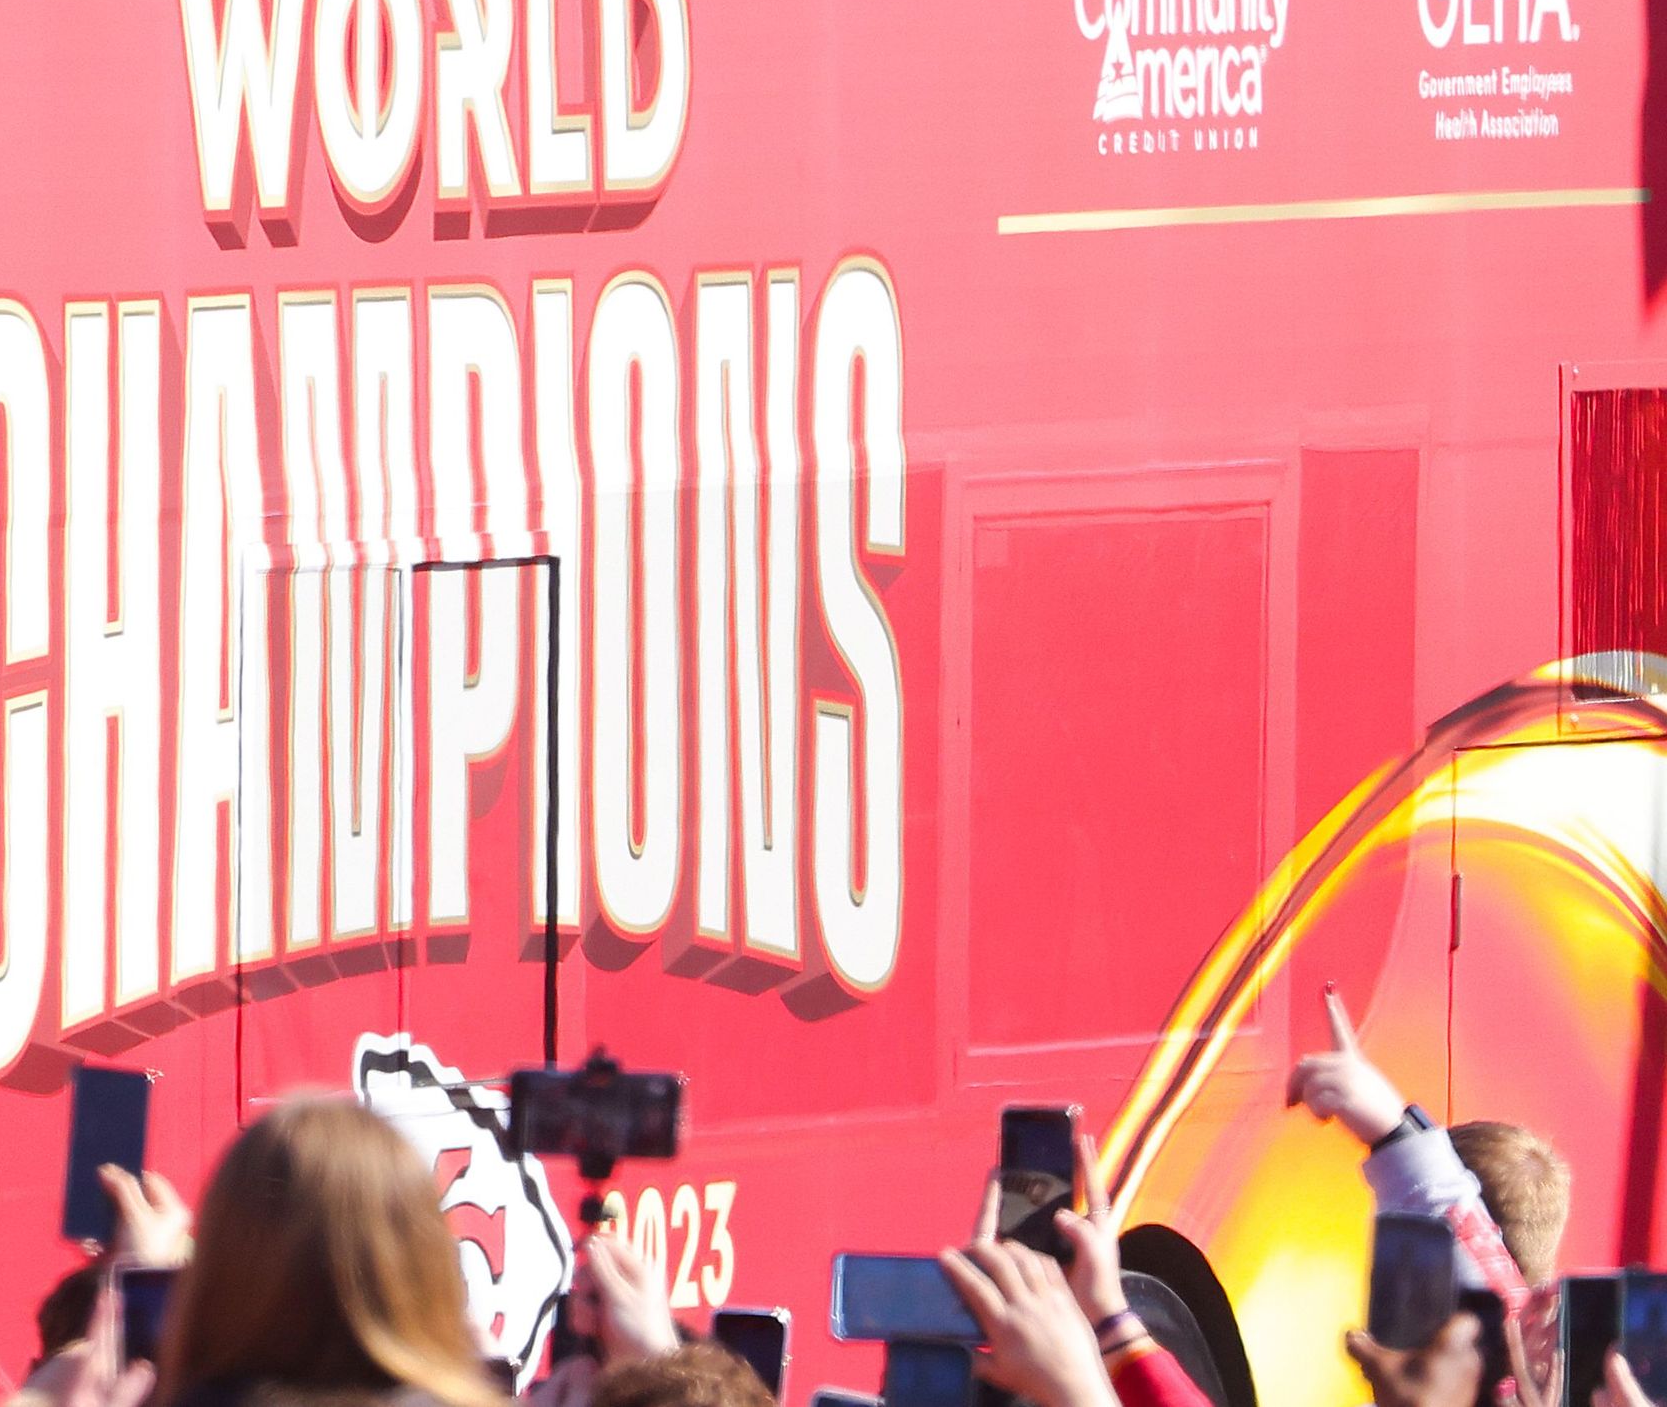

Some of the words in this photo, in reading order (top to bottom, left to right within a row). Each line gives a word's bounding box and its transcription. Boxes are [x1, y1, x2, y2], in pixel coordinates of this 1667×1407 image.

[1092, 28, 1263, 124] America
[1418, 69, 1498, 99] Government
[1480, 107, 1560, 139] Association
[1097, 128, 1181, 156] CREDIT
[1193, 126, 1259, 152] UNION
